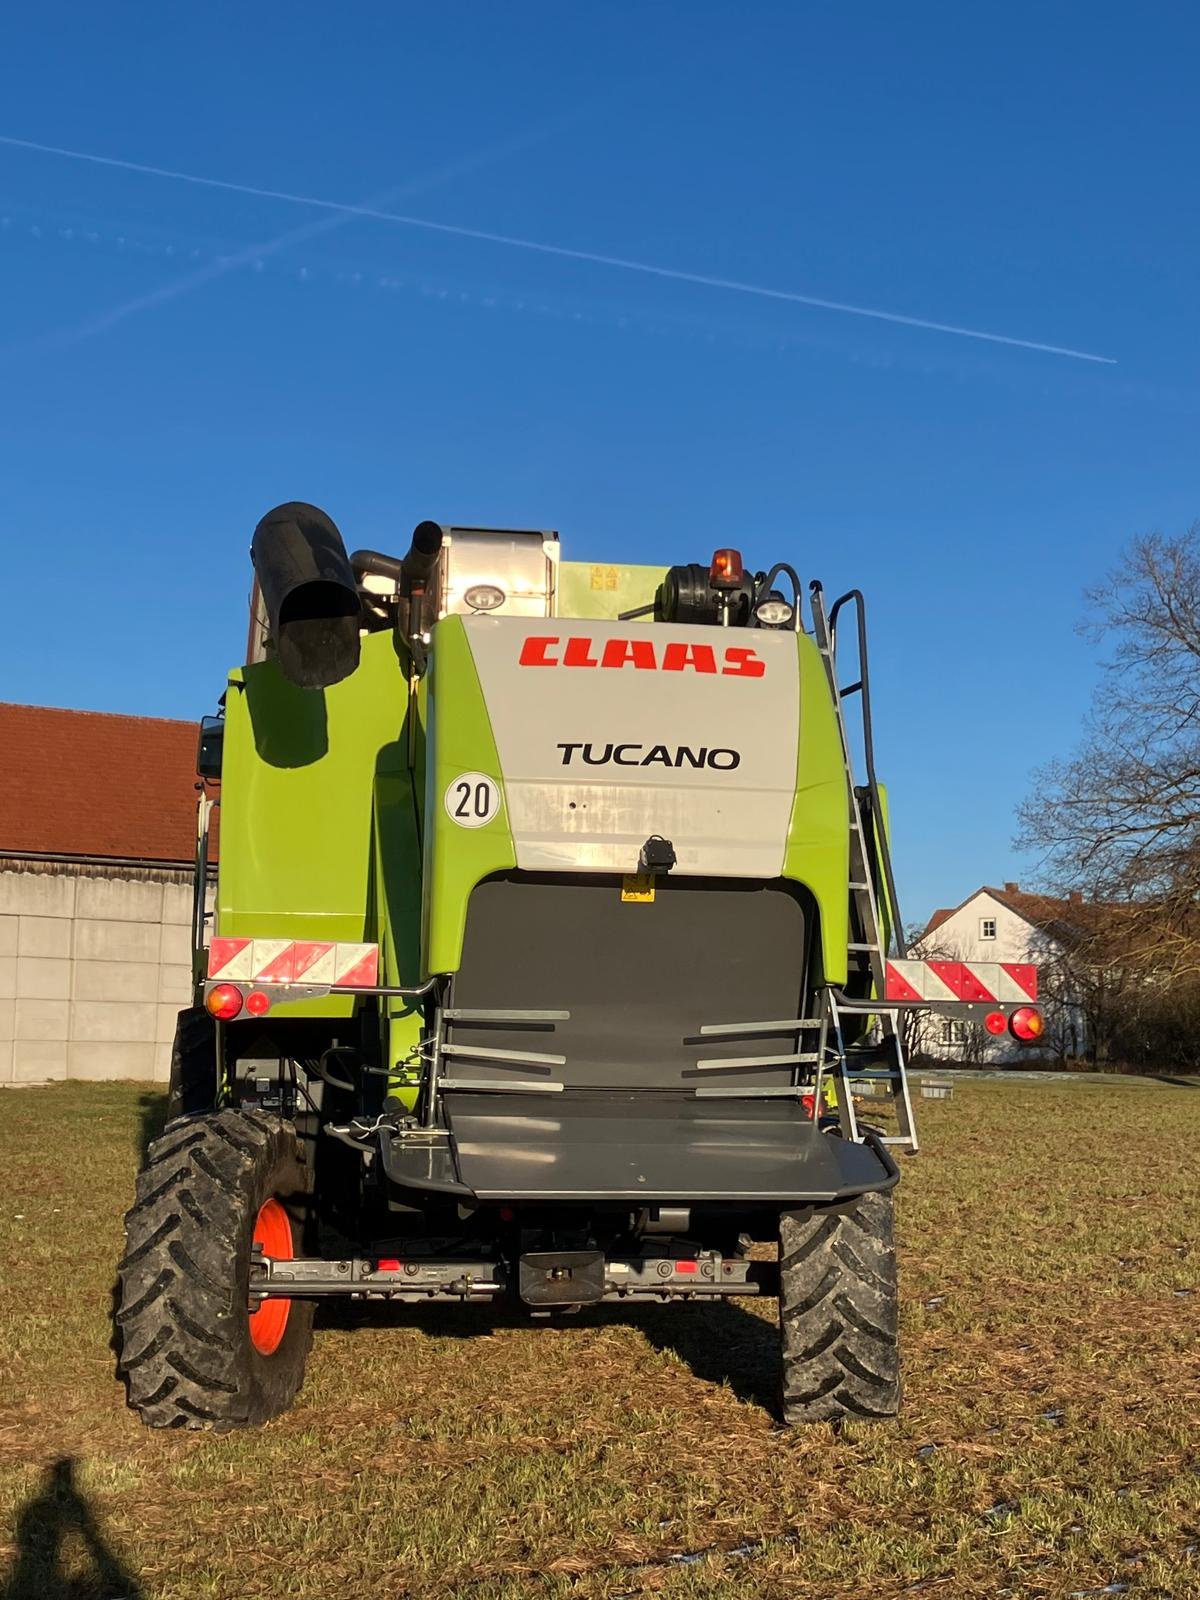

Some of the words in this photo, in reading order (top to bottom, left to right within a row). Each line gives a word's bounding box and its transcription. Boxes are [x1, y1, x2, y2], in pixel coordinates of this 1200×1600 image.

[519, 637, 765, 677] CLAAS
[557, 743, 740, 770] TUCANO
[455, 782, 491, 817] 20
